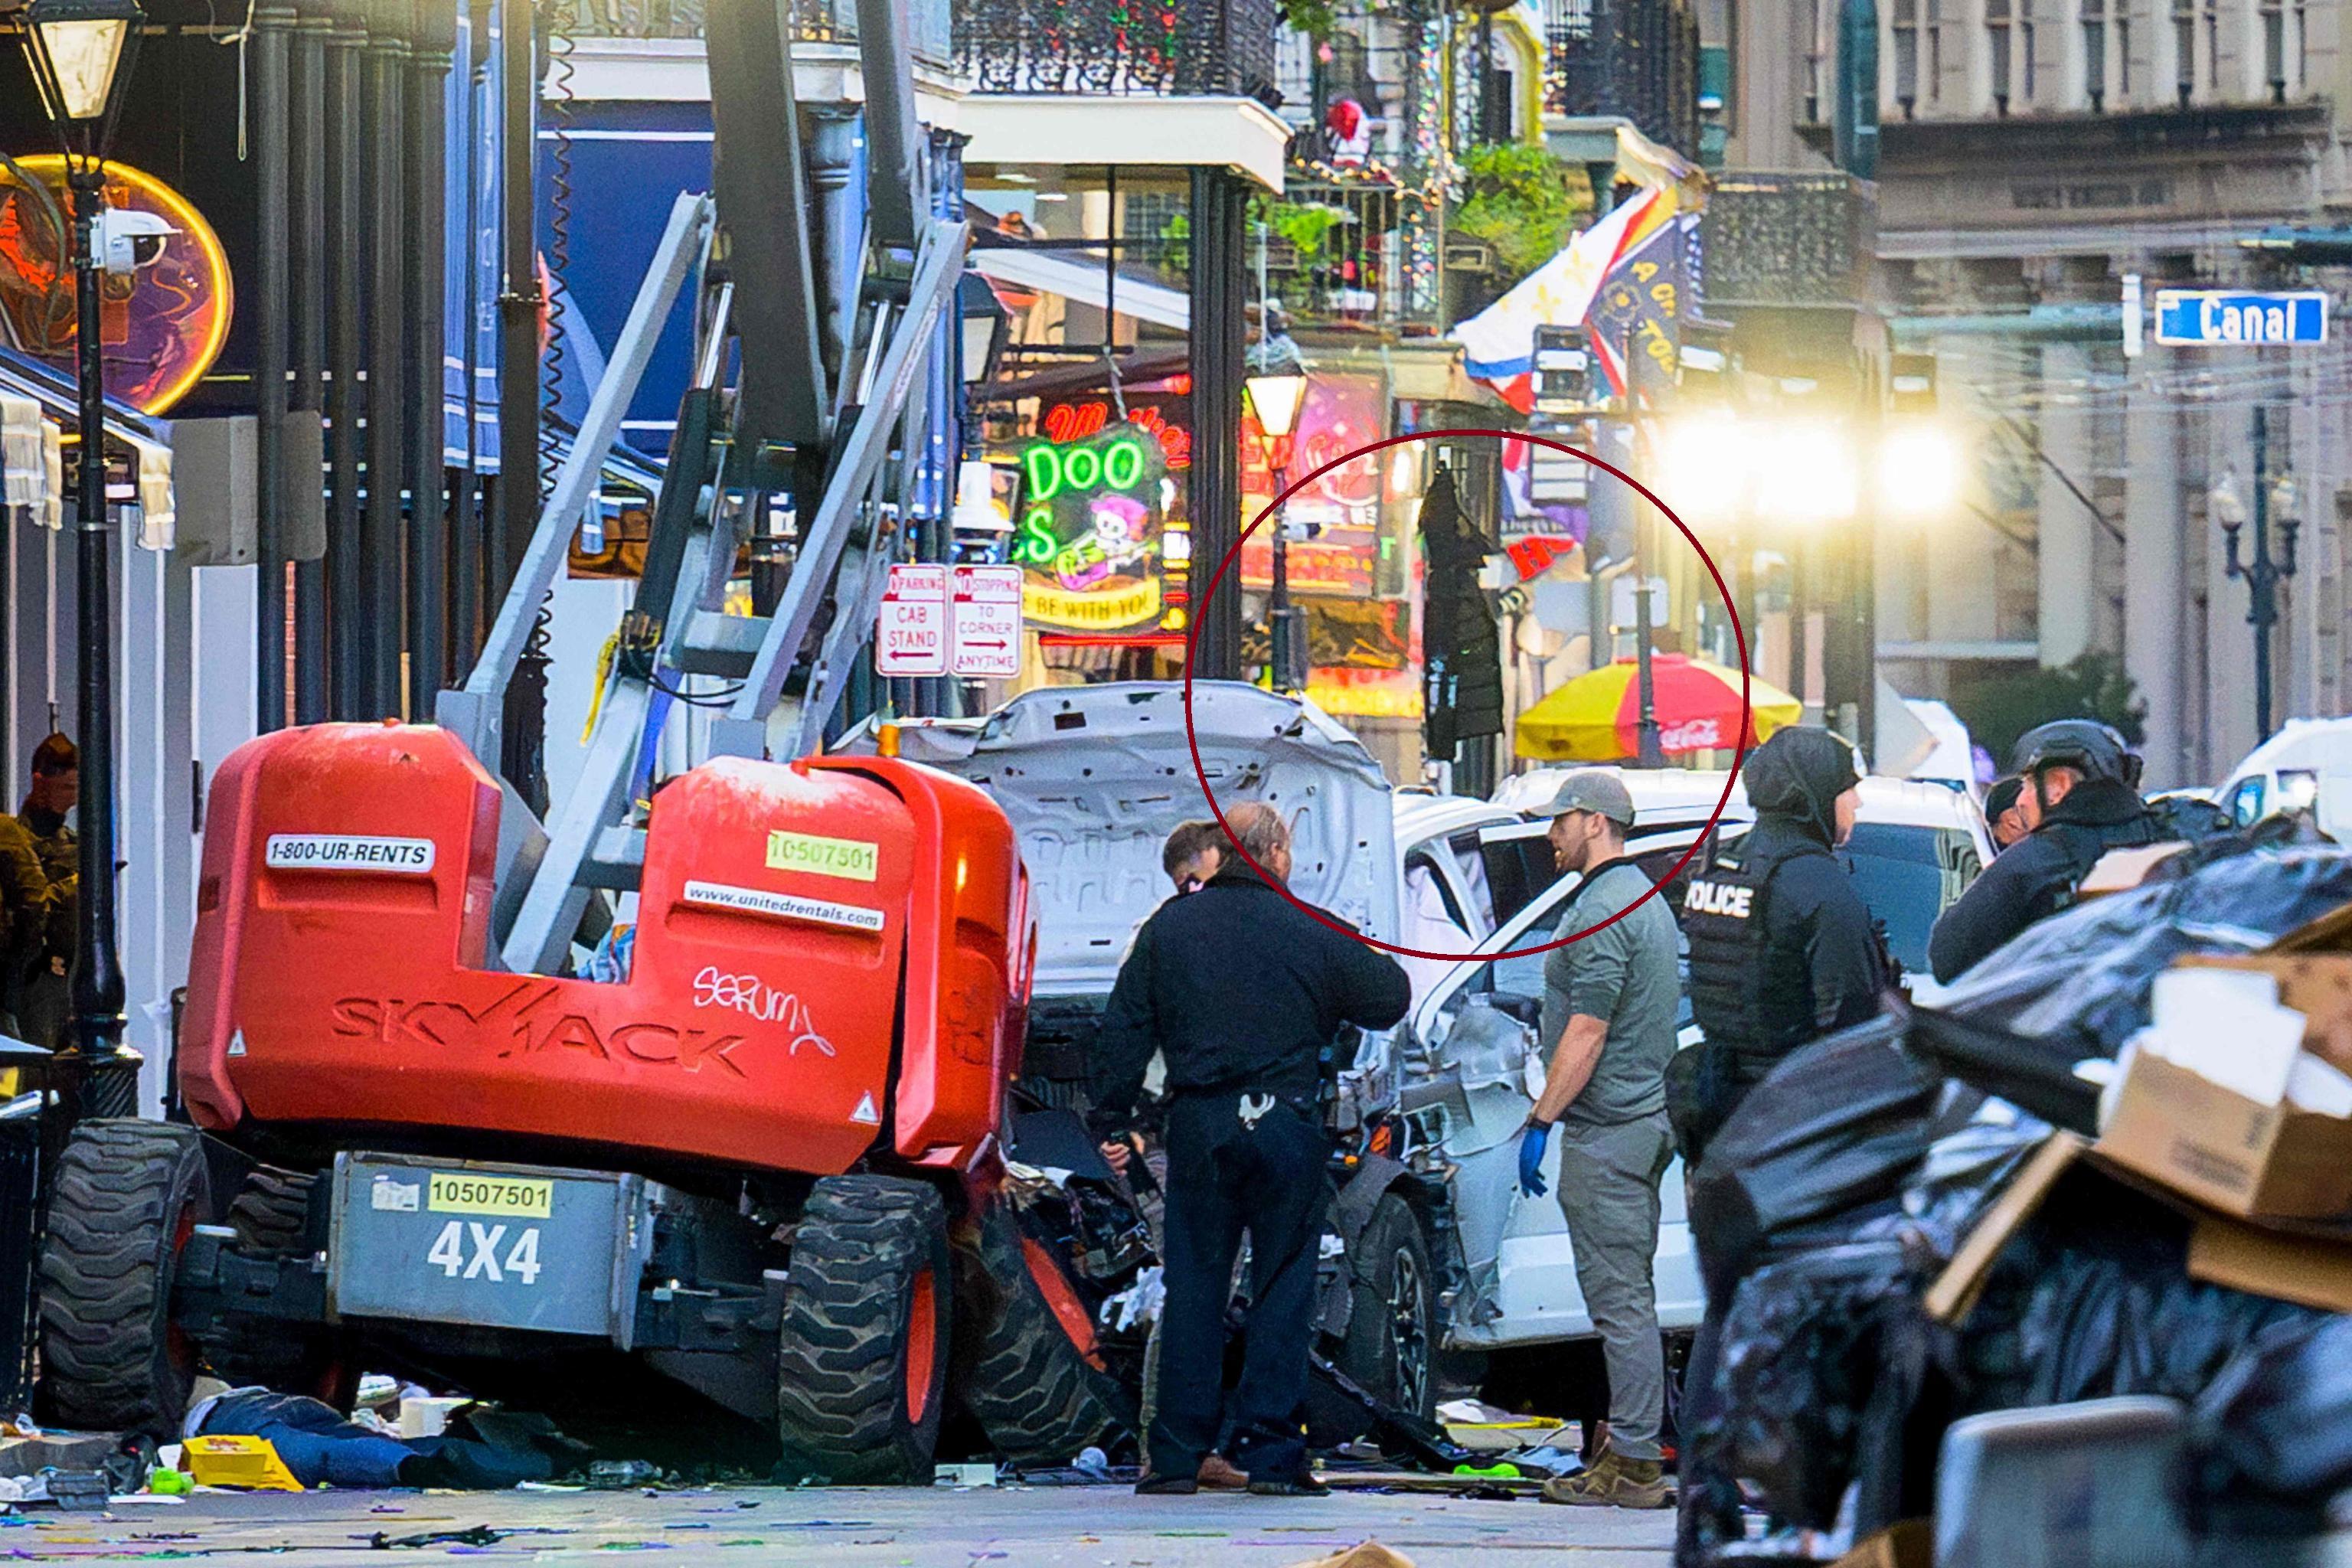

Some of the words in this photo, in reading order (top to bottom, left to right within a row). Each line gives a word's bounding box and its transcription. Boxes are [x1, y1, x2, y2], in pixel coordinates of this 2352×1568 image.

[2200, 297, 2296, 341] Canal
[1027, 440, 1143, 501] DOO
[899, 577, 944, 591] PARKING
[897, 606, 928, 624] CAB
[978, 606, 995, 618] TO
[1065, 600, 1111, 621] WITH
[887, 630, 938, 648] STAND
[959, 622, 1013, 635] CORNER
[957, 655, 1015, 670] ANYTIME
[271, 841, 426, 864] 1-800-UR-RENTS
[770, 837, 873, 871] 10507501
[689, 887, 879, 927] www.unitedrentals.com
[331, 982, 747, 1079] SKYJACK
[433, 1181, 547, 1208] 10507501
[427, 1220, 542, 1285] 4X4
